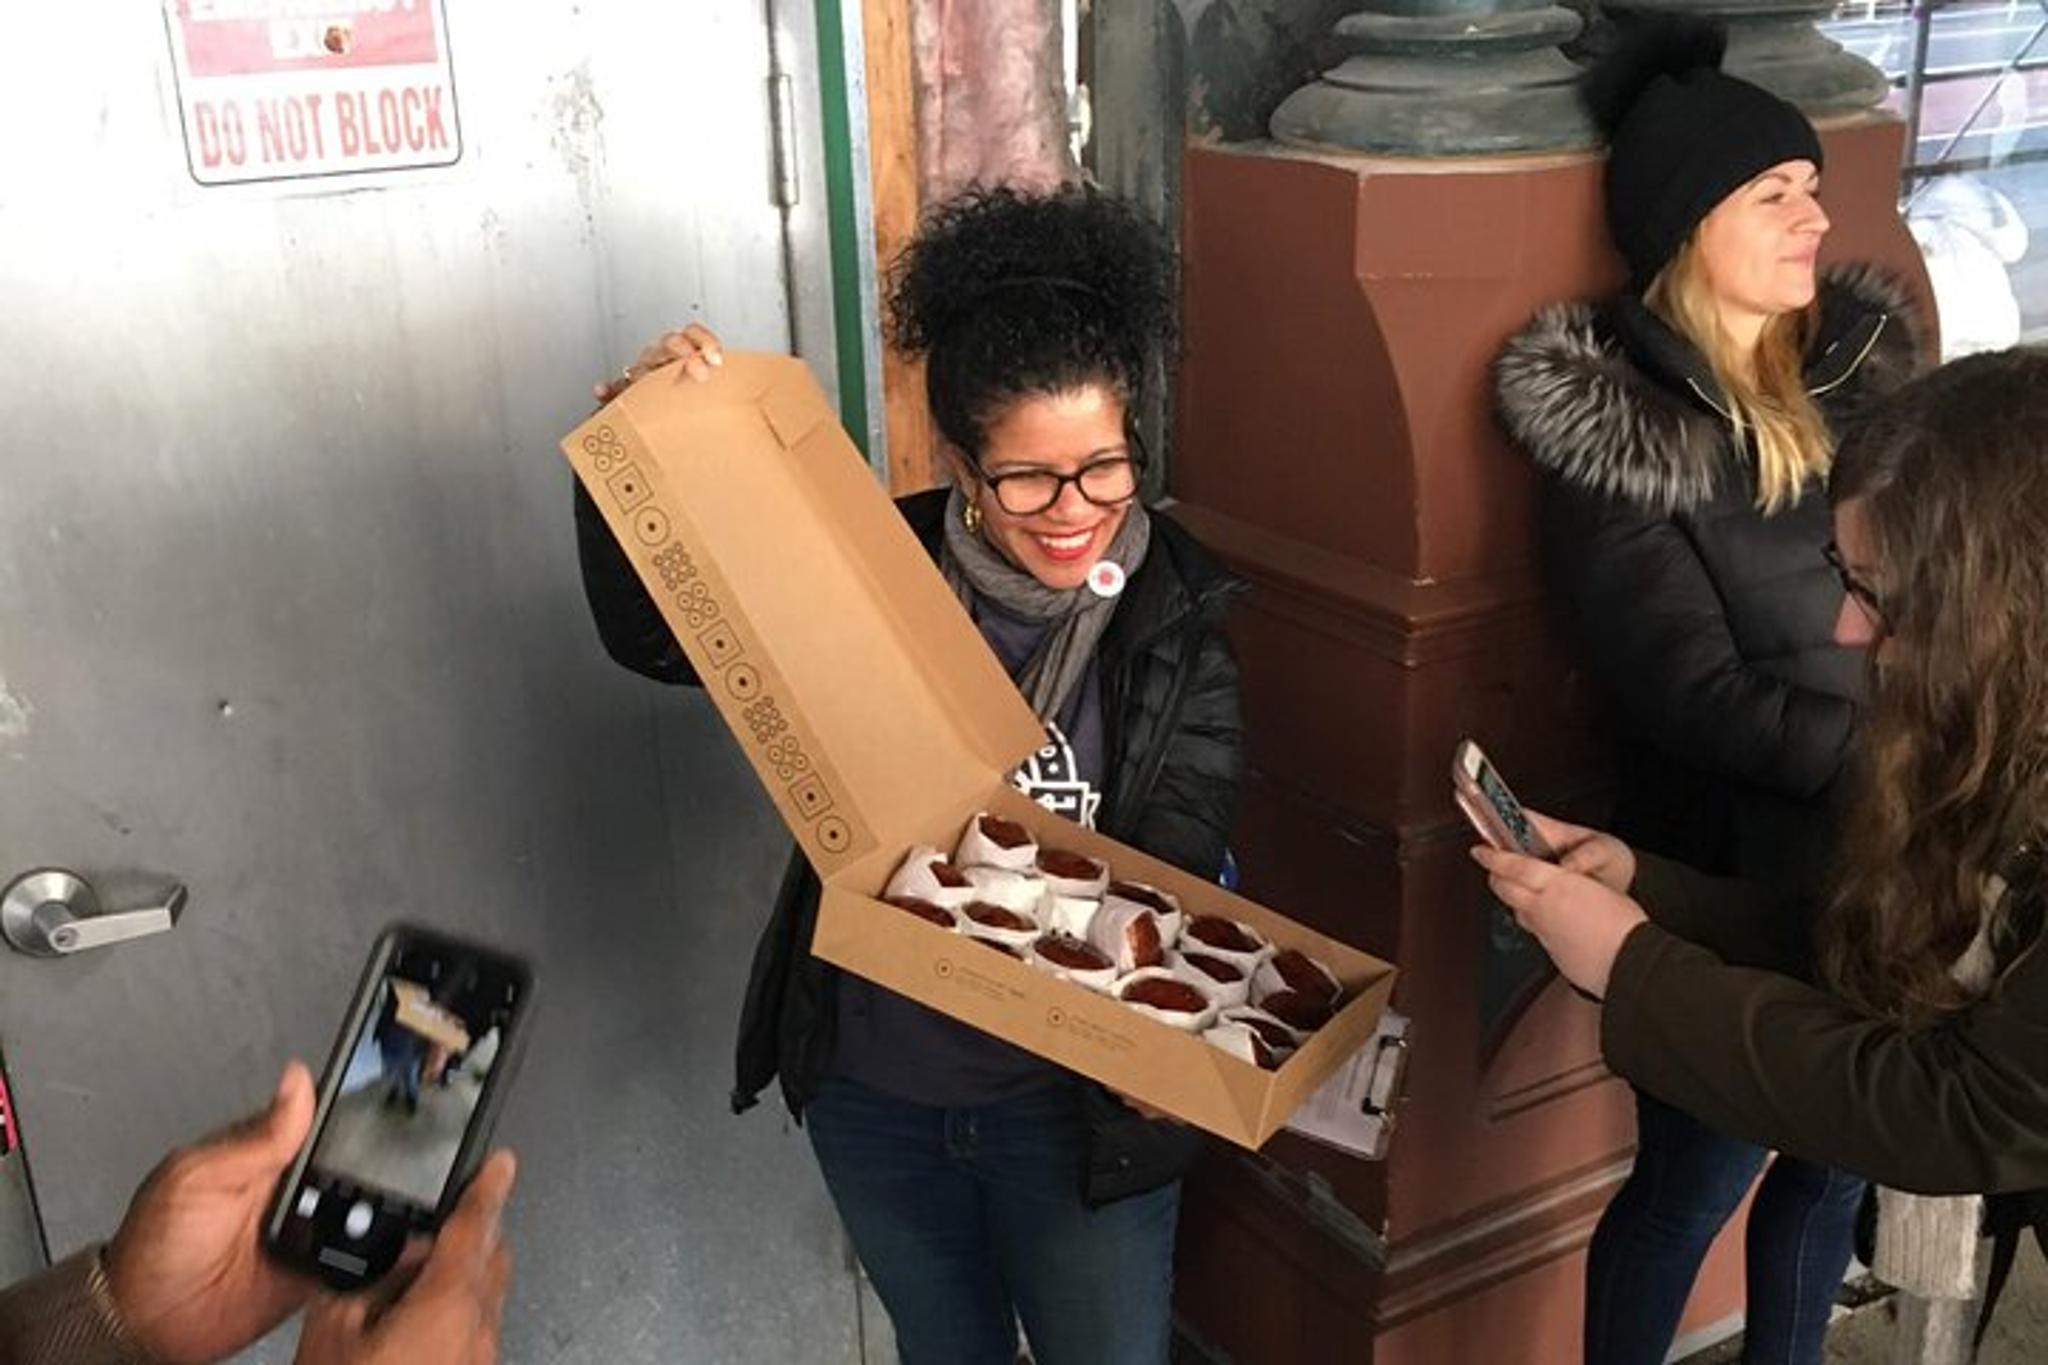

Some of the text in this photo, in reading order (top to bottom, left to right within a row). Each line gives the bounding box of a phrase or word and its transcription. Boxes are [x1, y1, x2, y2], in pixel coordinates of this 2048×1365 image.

[194, 85, 449, 168] DO NOT BLOCK
